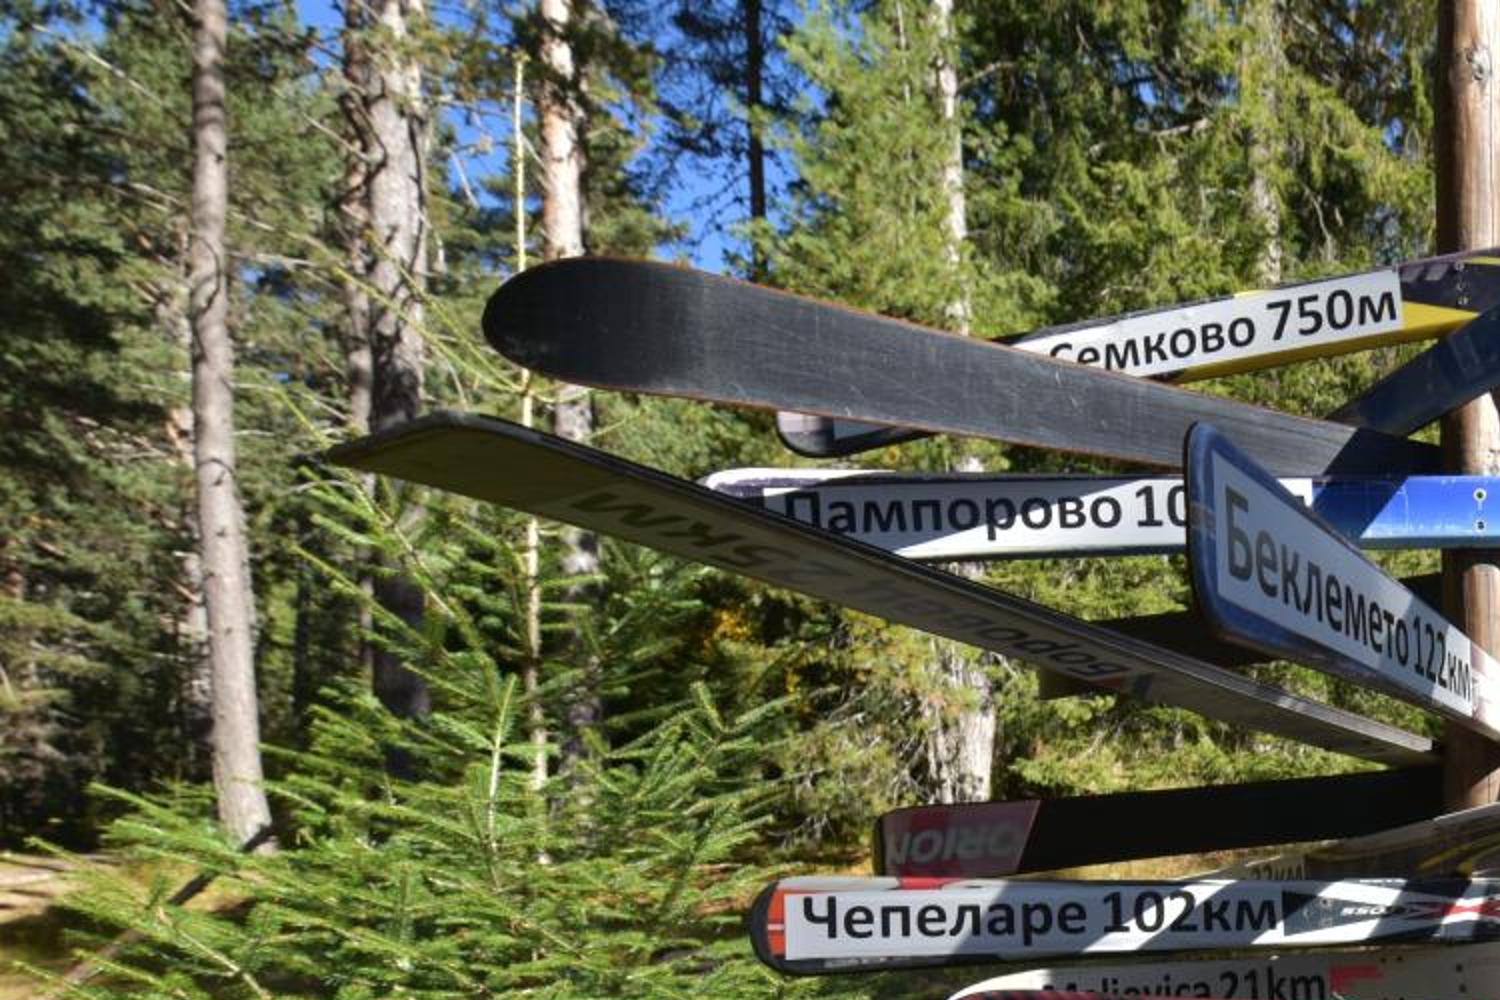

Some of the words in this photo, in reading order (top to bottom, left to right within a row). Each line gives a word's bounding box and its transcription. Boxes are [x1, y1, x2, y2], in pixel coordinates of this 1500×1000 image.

[1050, 316, 1256, 371] Семково
[1266, 288, 1398, 342] 750м
[784, 492, 1122, 540] Пампорово
[1225, 486, 1410, 666] Беклемето
[1412, 616, 1473, 701] 122км
[803, 895, 1088, 948] Чепеларе
[1102, 889, 1279, 935] 102км
